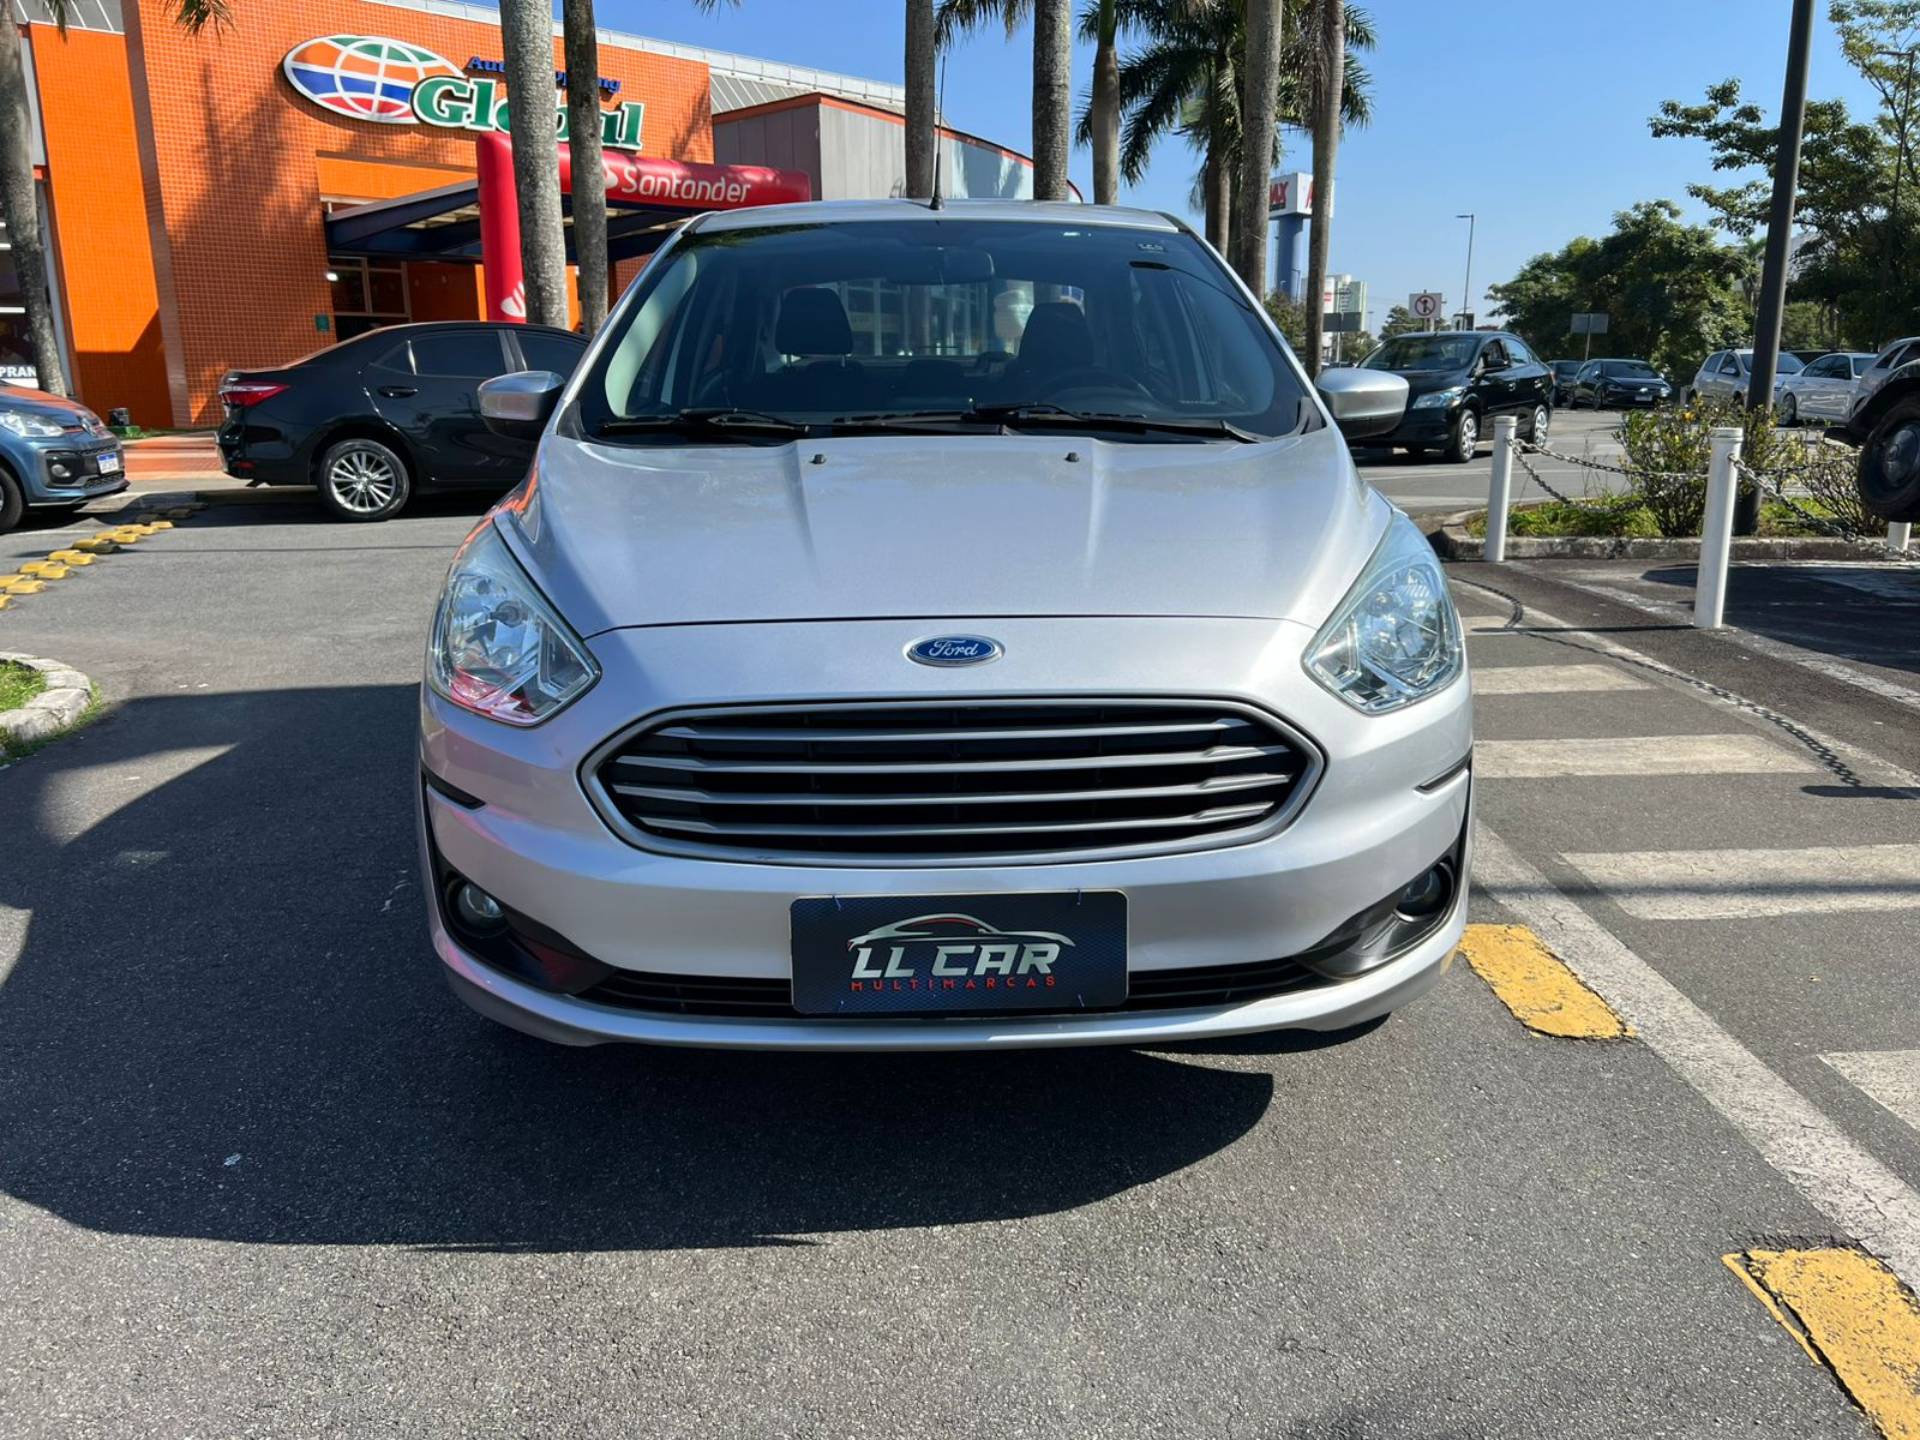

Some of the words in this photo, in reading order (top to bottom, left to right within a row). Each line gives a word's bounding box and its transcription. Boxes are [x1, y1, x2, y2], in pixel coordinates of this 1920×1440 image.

[466, 56, 506, 73] Aut
[621, 165, 752, 202] Santander
[928, 639, 979, 657] Ford
[851, 947, 915, 978] LL
[931, 943, 1060, 976] CAR
[851, 976, 1056, 992] MULTIMARCAS
